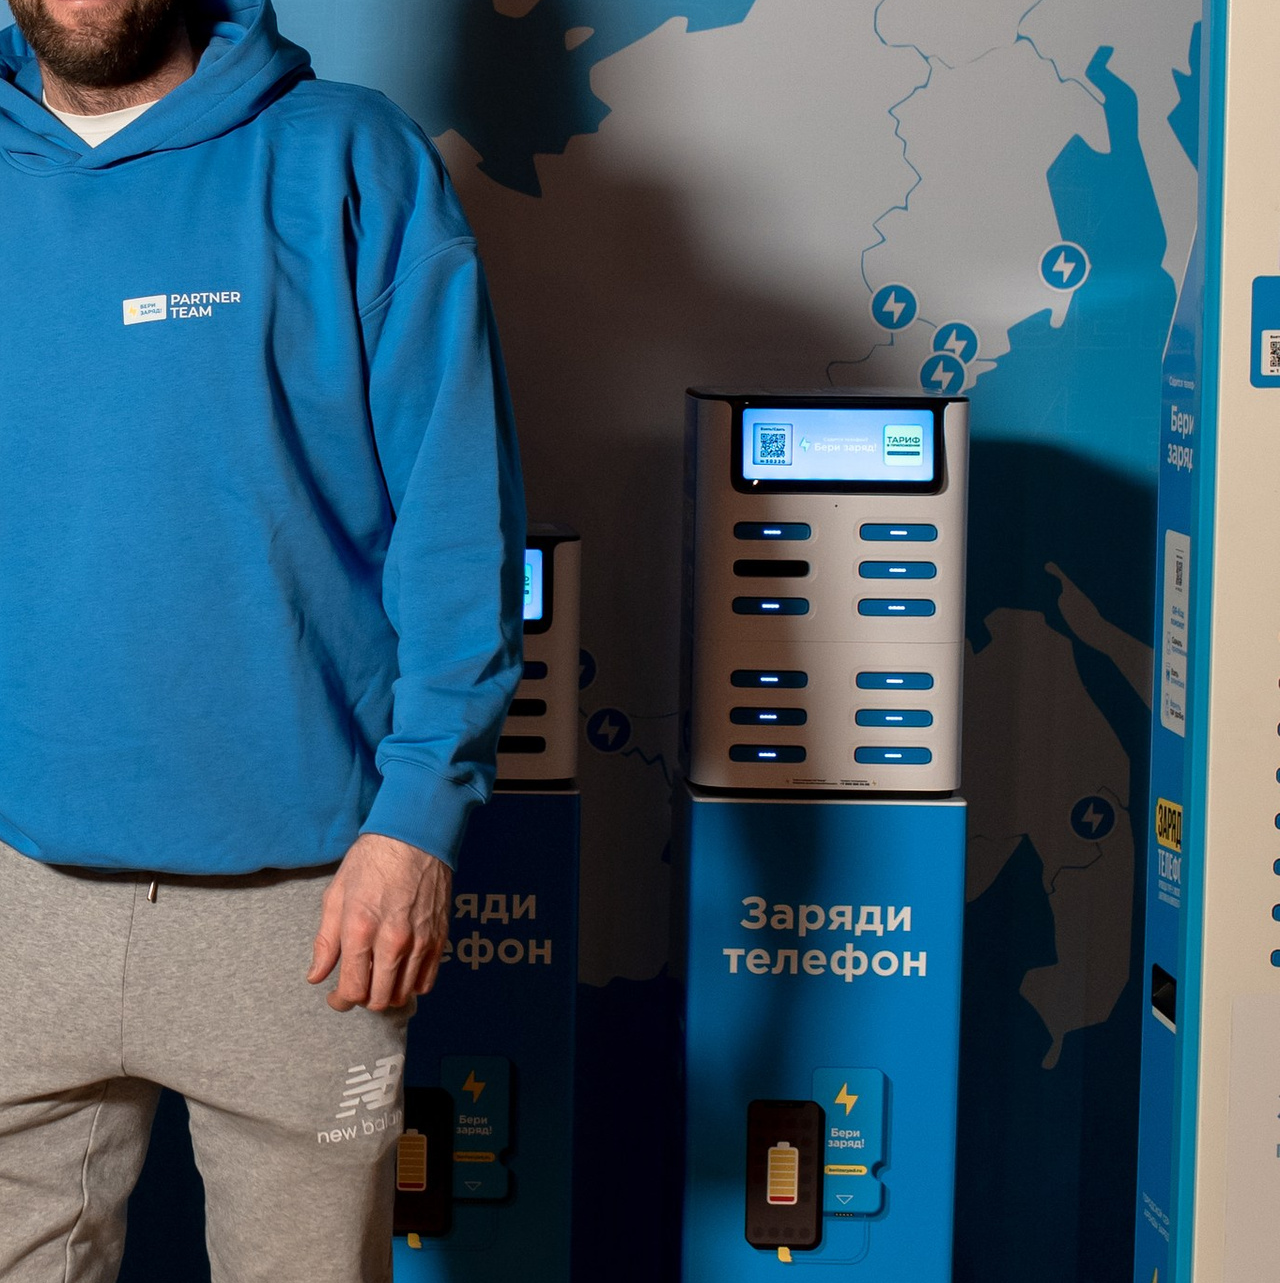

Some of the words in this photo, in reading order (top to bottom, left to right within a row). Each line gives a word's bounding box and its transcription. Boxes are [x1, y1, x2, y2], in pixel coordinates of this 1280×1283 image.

[170, 291, 241, 306] PARTNER
[170, 306, 213, 319] TEAM
[886, 436, 921, 444] ТАРИФ
[814, 442, 841, 454] Бери
[843, 442, 877, 455] заряд!
[1157, 803, 1182, 850] ЗАРЯД
[454, 892, 537, 925] яди
[739, 895, 913, 938] Заряди
[438, 930, 553, 971] ефон
[722, 942, 928, 983] телефон
[458, 1114, 489, 1126] Бери
[317, 1125, 357, 1144] new
[455, 1125, 493, 1136] заряд!
[830, 1127, 861, 1139] Бери
[827, 1138, 865, 1149] заряд!
